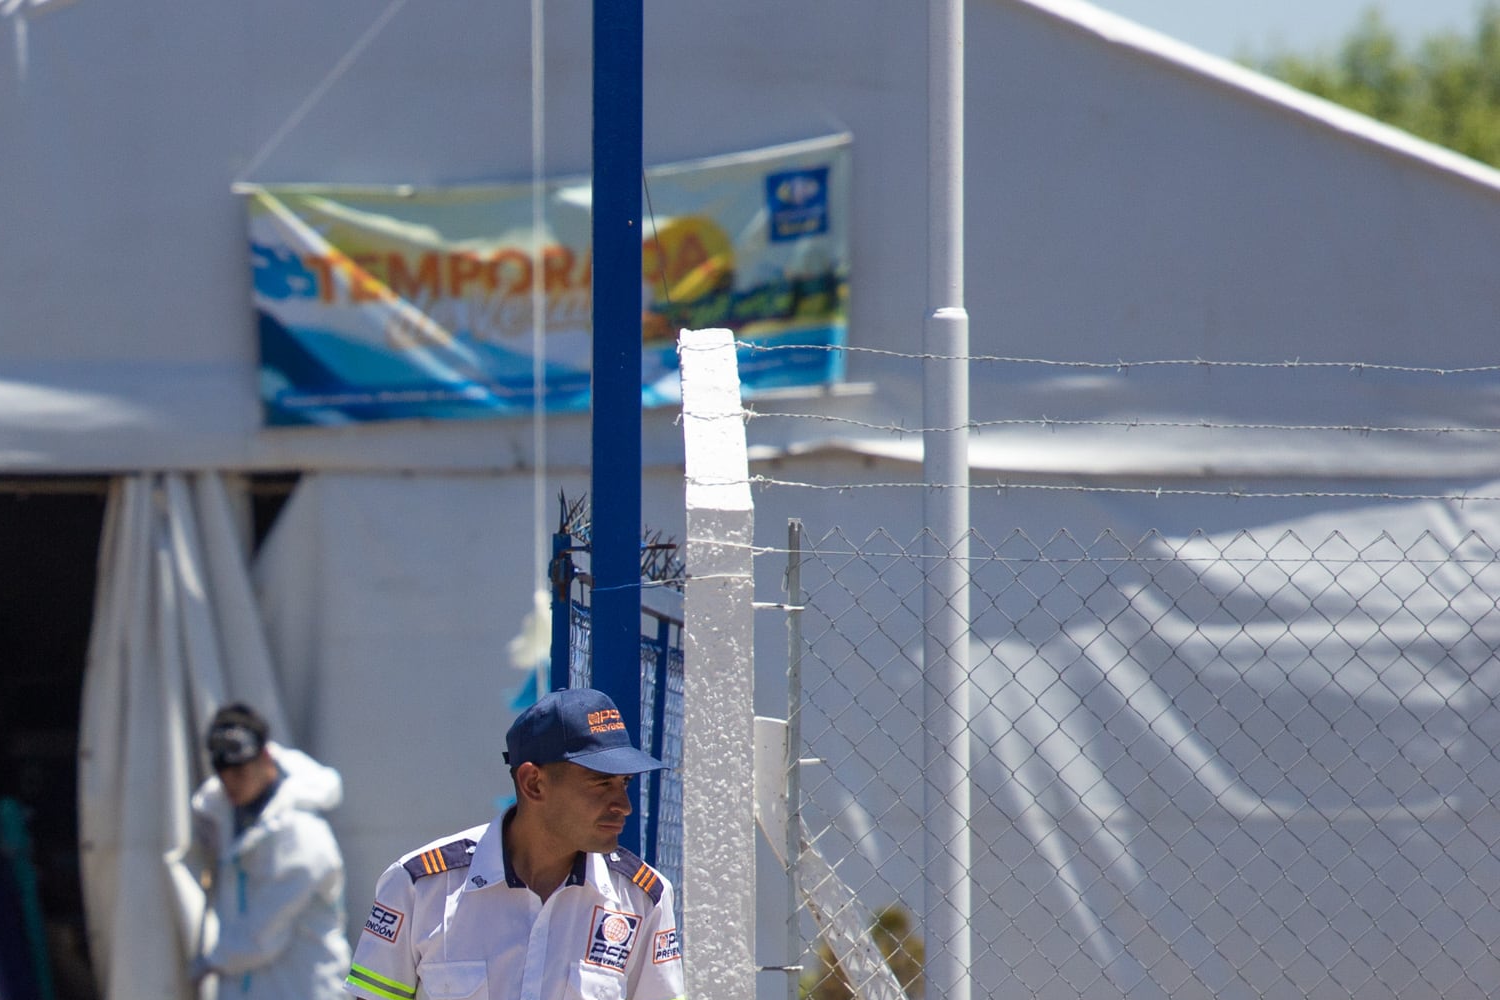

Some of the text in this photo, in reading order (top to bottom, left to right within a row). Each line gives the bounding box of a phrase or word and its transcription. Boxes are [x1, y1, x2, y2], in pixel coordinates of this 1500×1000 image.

[303, 230, 718, 306] TEMPORDA
[600, 709, 620, 723] PC
[372, 905, 398, 925] CP
[591, 942, 631, 961] PCP
